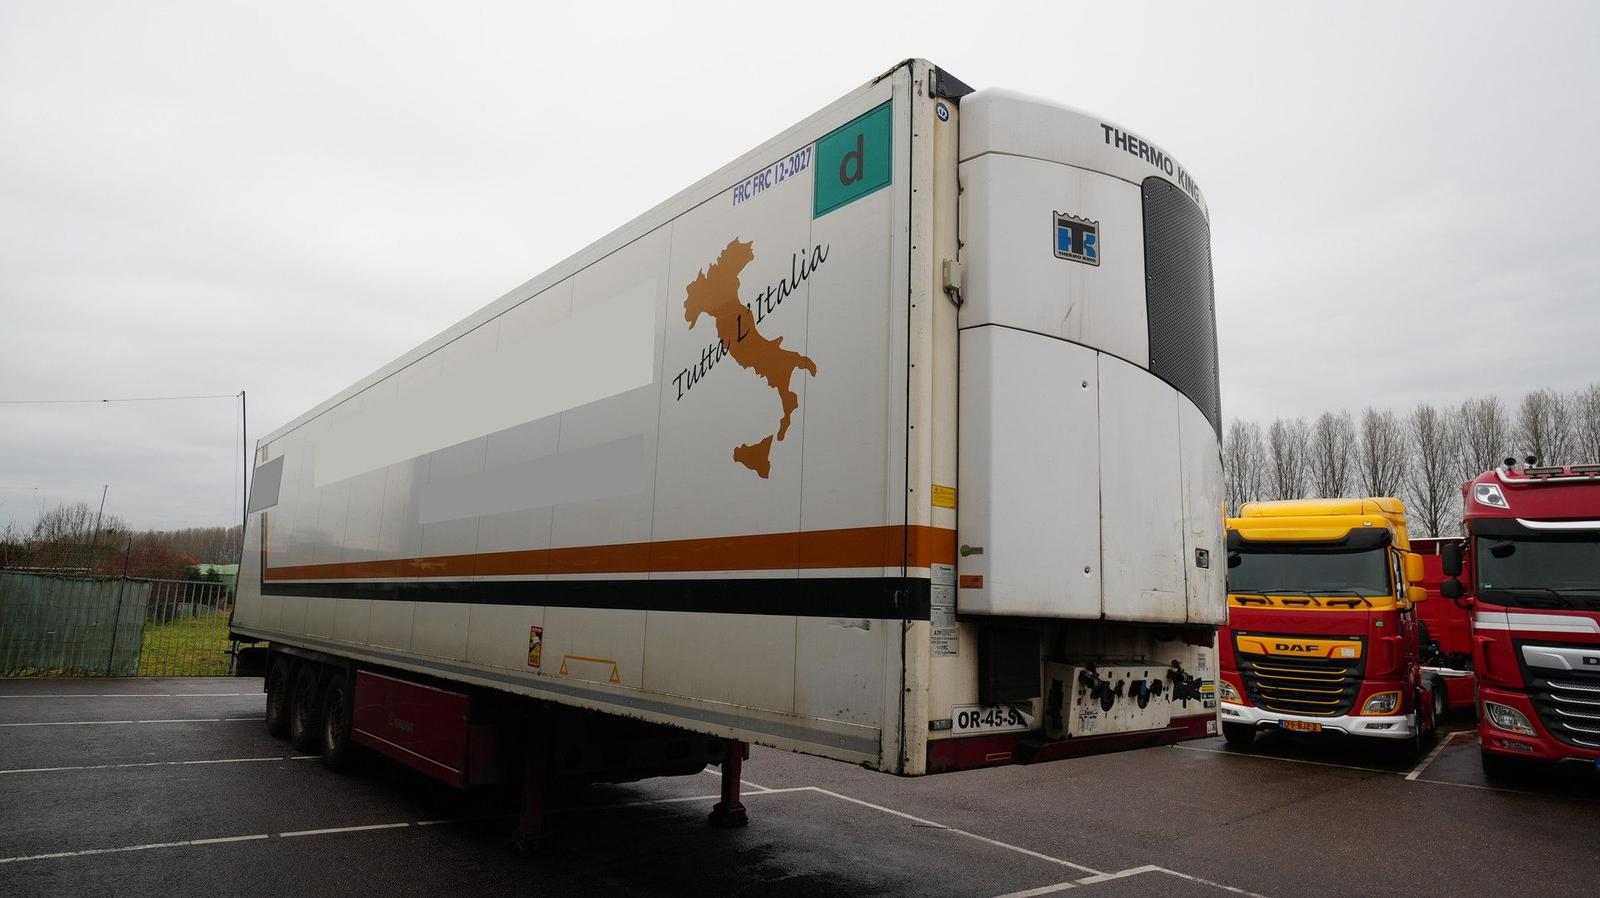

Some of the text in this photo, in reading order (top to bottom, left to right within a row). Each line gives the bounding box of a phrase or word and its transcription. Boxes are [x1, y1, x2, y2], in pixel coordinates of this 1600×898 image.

[732, 147, 812, 206] FRC FRC 12-2027
[840, 134, 864, 186] d
[1100, 122, 1200, 202] THERMO KING
[672, 338, 731, 401] Tutta
[1274, 643, 1320, 653] DAF
